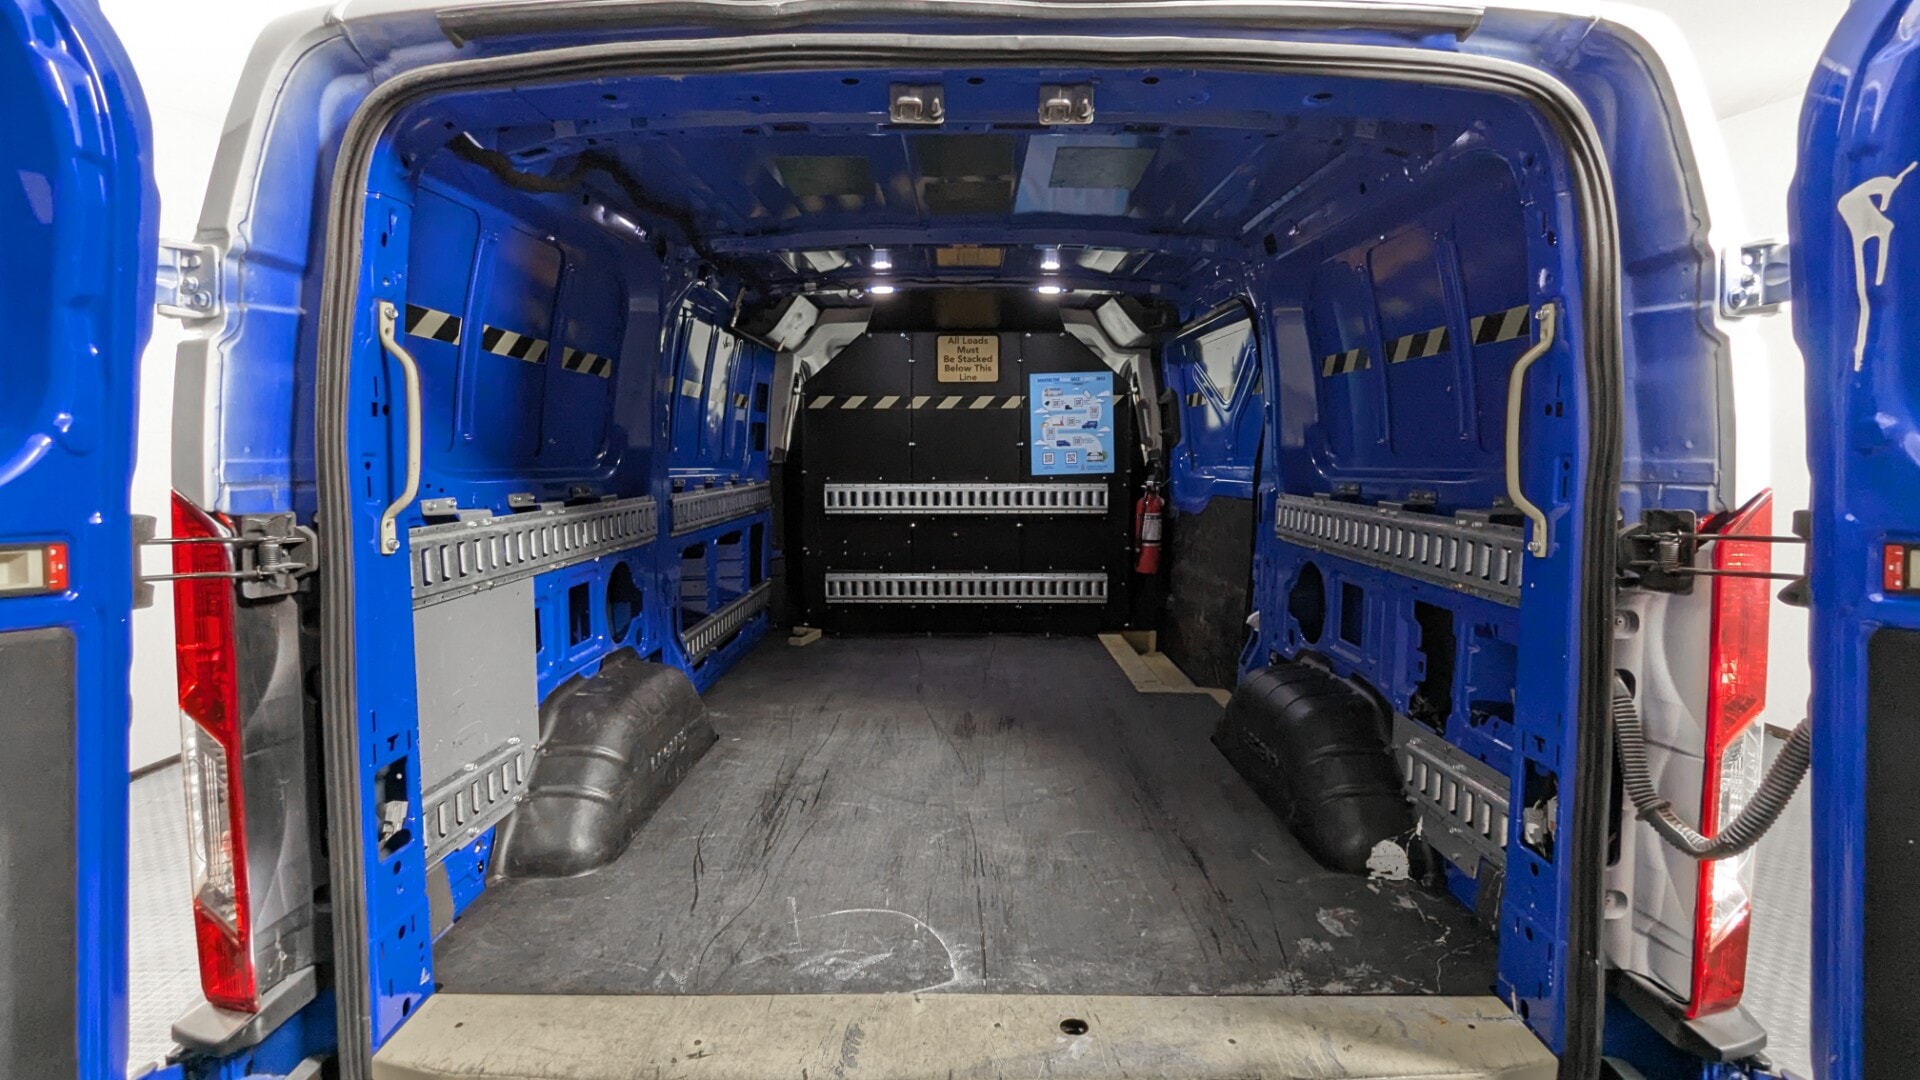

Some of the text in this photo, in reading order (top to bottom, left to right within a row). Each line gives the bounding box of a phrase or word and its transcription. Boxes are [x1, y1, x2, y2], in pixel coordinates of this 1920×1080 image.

[948, 336, 989, 345] All Loads
[957, 345, 979, 354] Must
[943, 354, 993, 363] Be Stacked
[944, 363, 992, 372] Below This
[960, 373, 977, 381] Line
